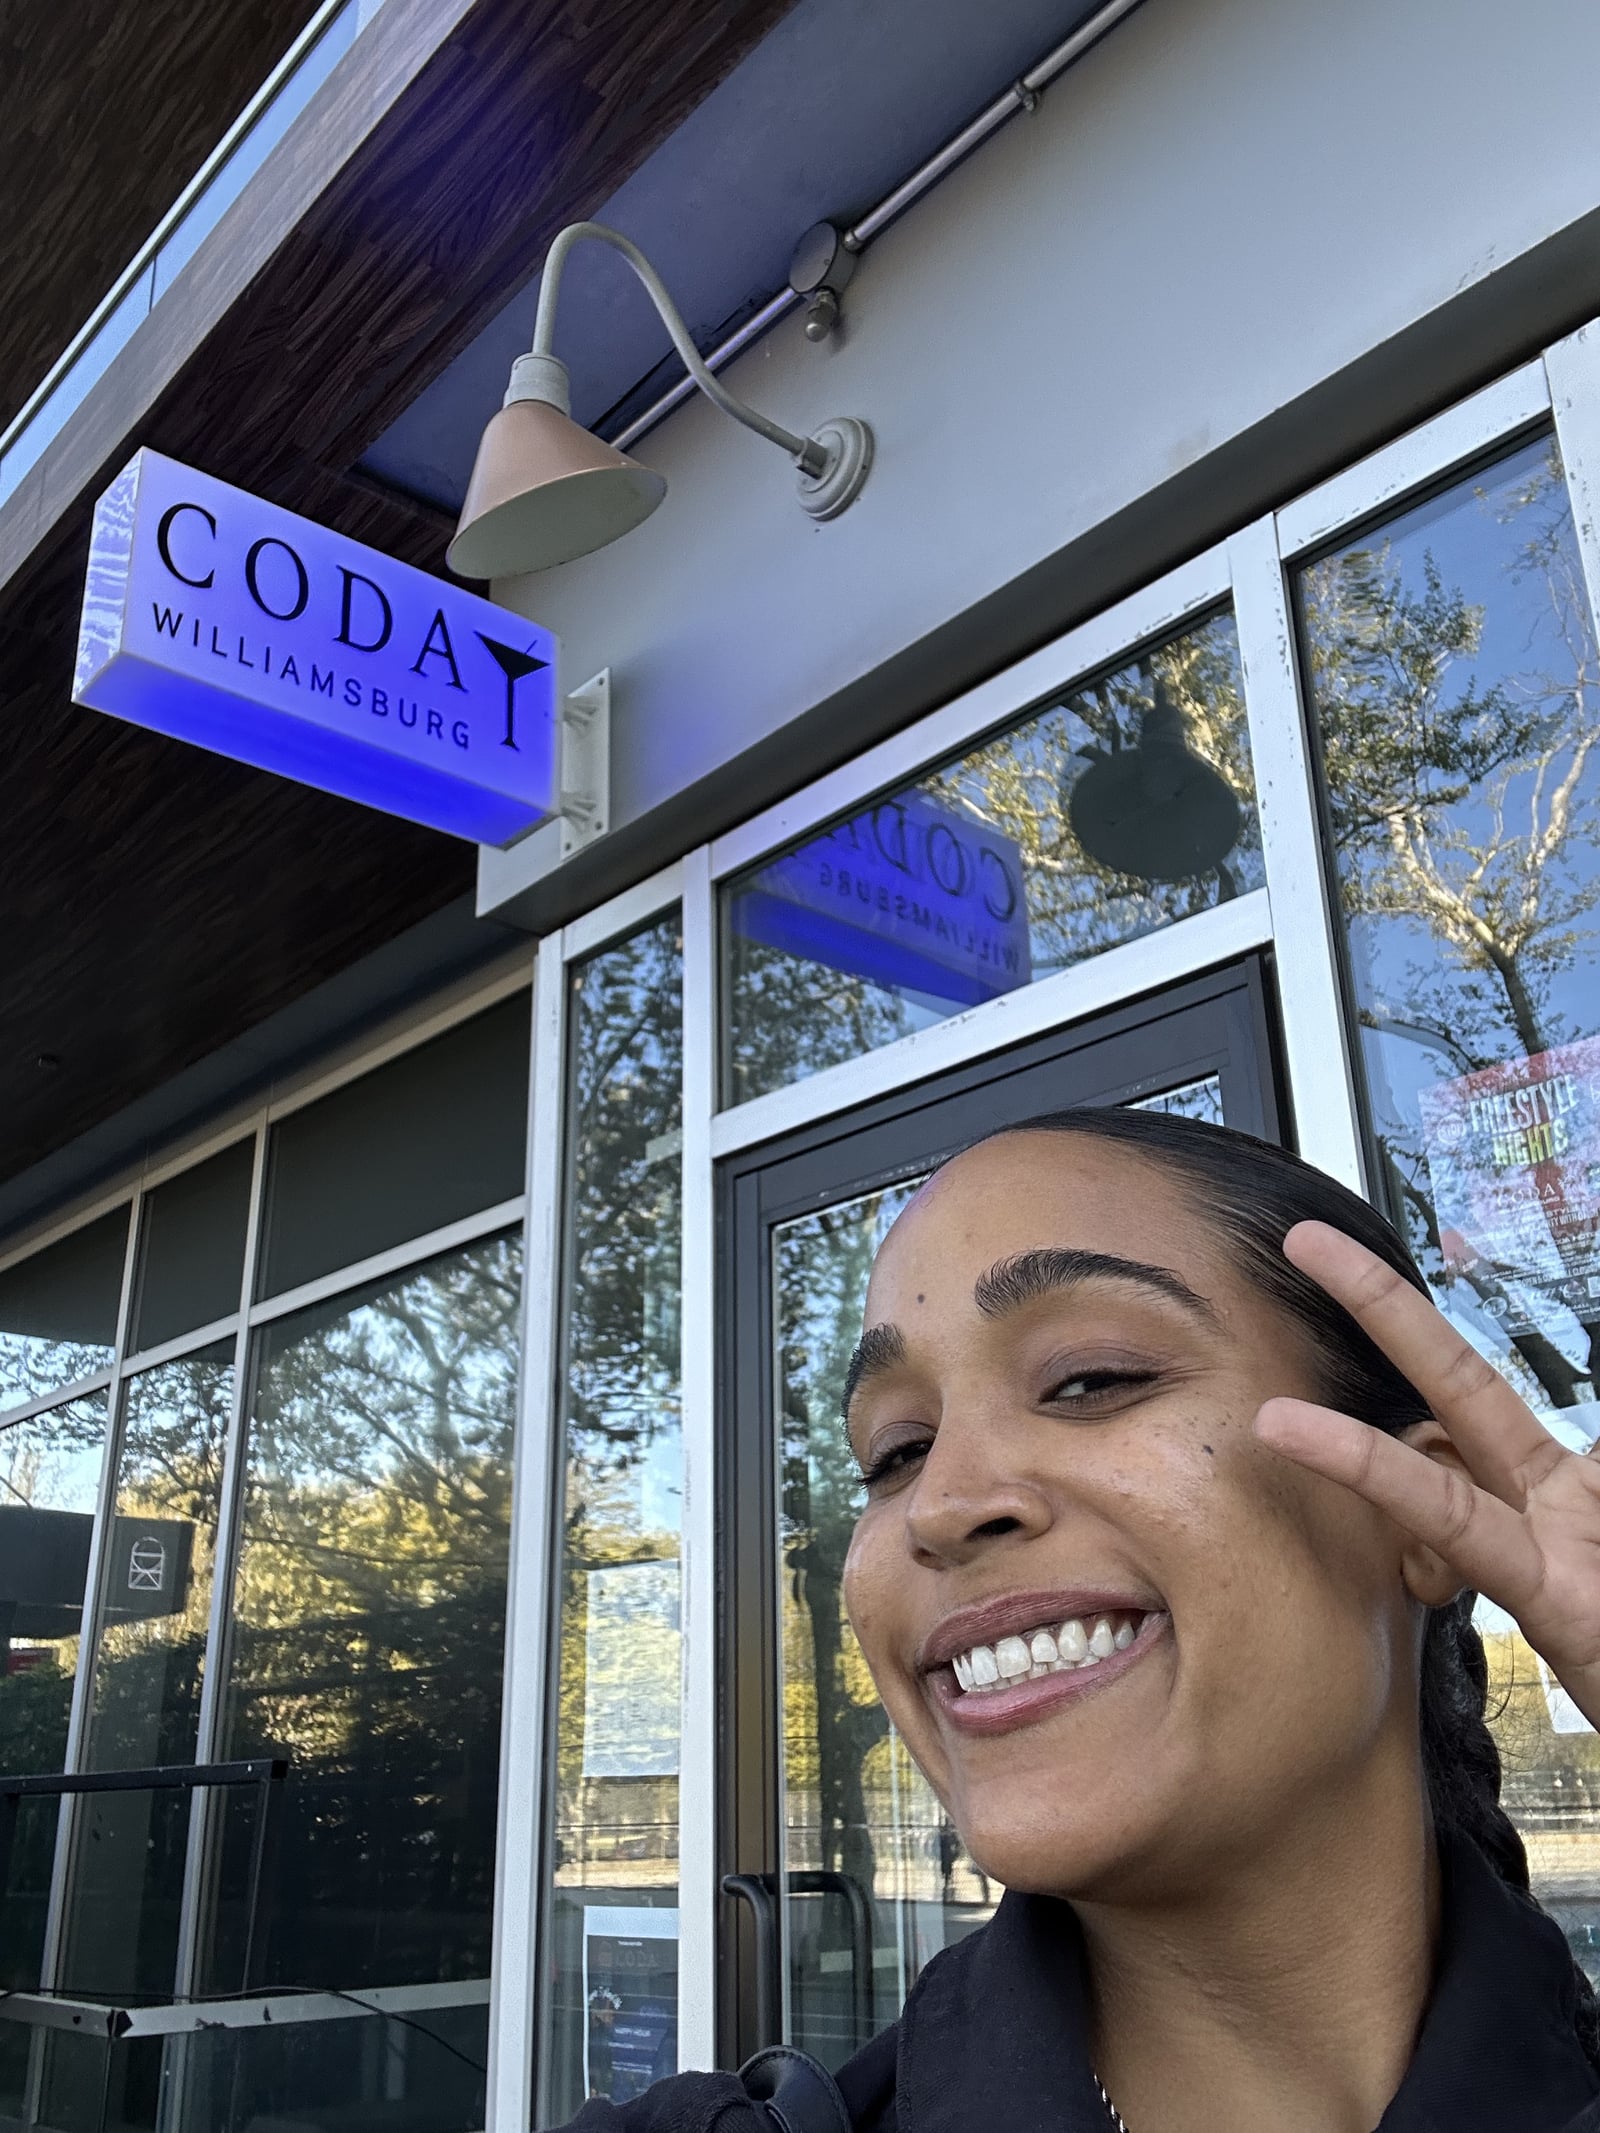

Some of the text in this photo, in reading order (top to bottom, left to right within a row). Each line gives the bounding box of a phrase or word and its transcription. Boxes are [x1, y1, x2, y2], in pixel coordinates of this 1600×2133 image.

[156, 502, 469, 693] CODA
[152, 603, 470, 750] WILLIAMSBURG
[1470, 1073, 1579, 1134] FREESTYLE
[1492, 1117, 1569, 1166] NIGHTS
